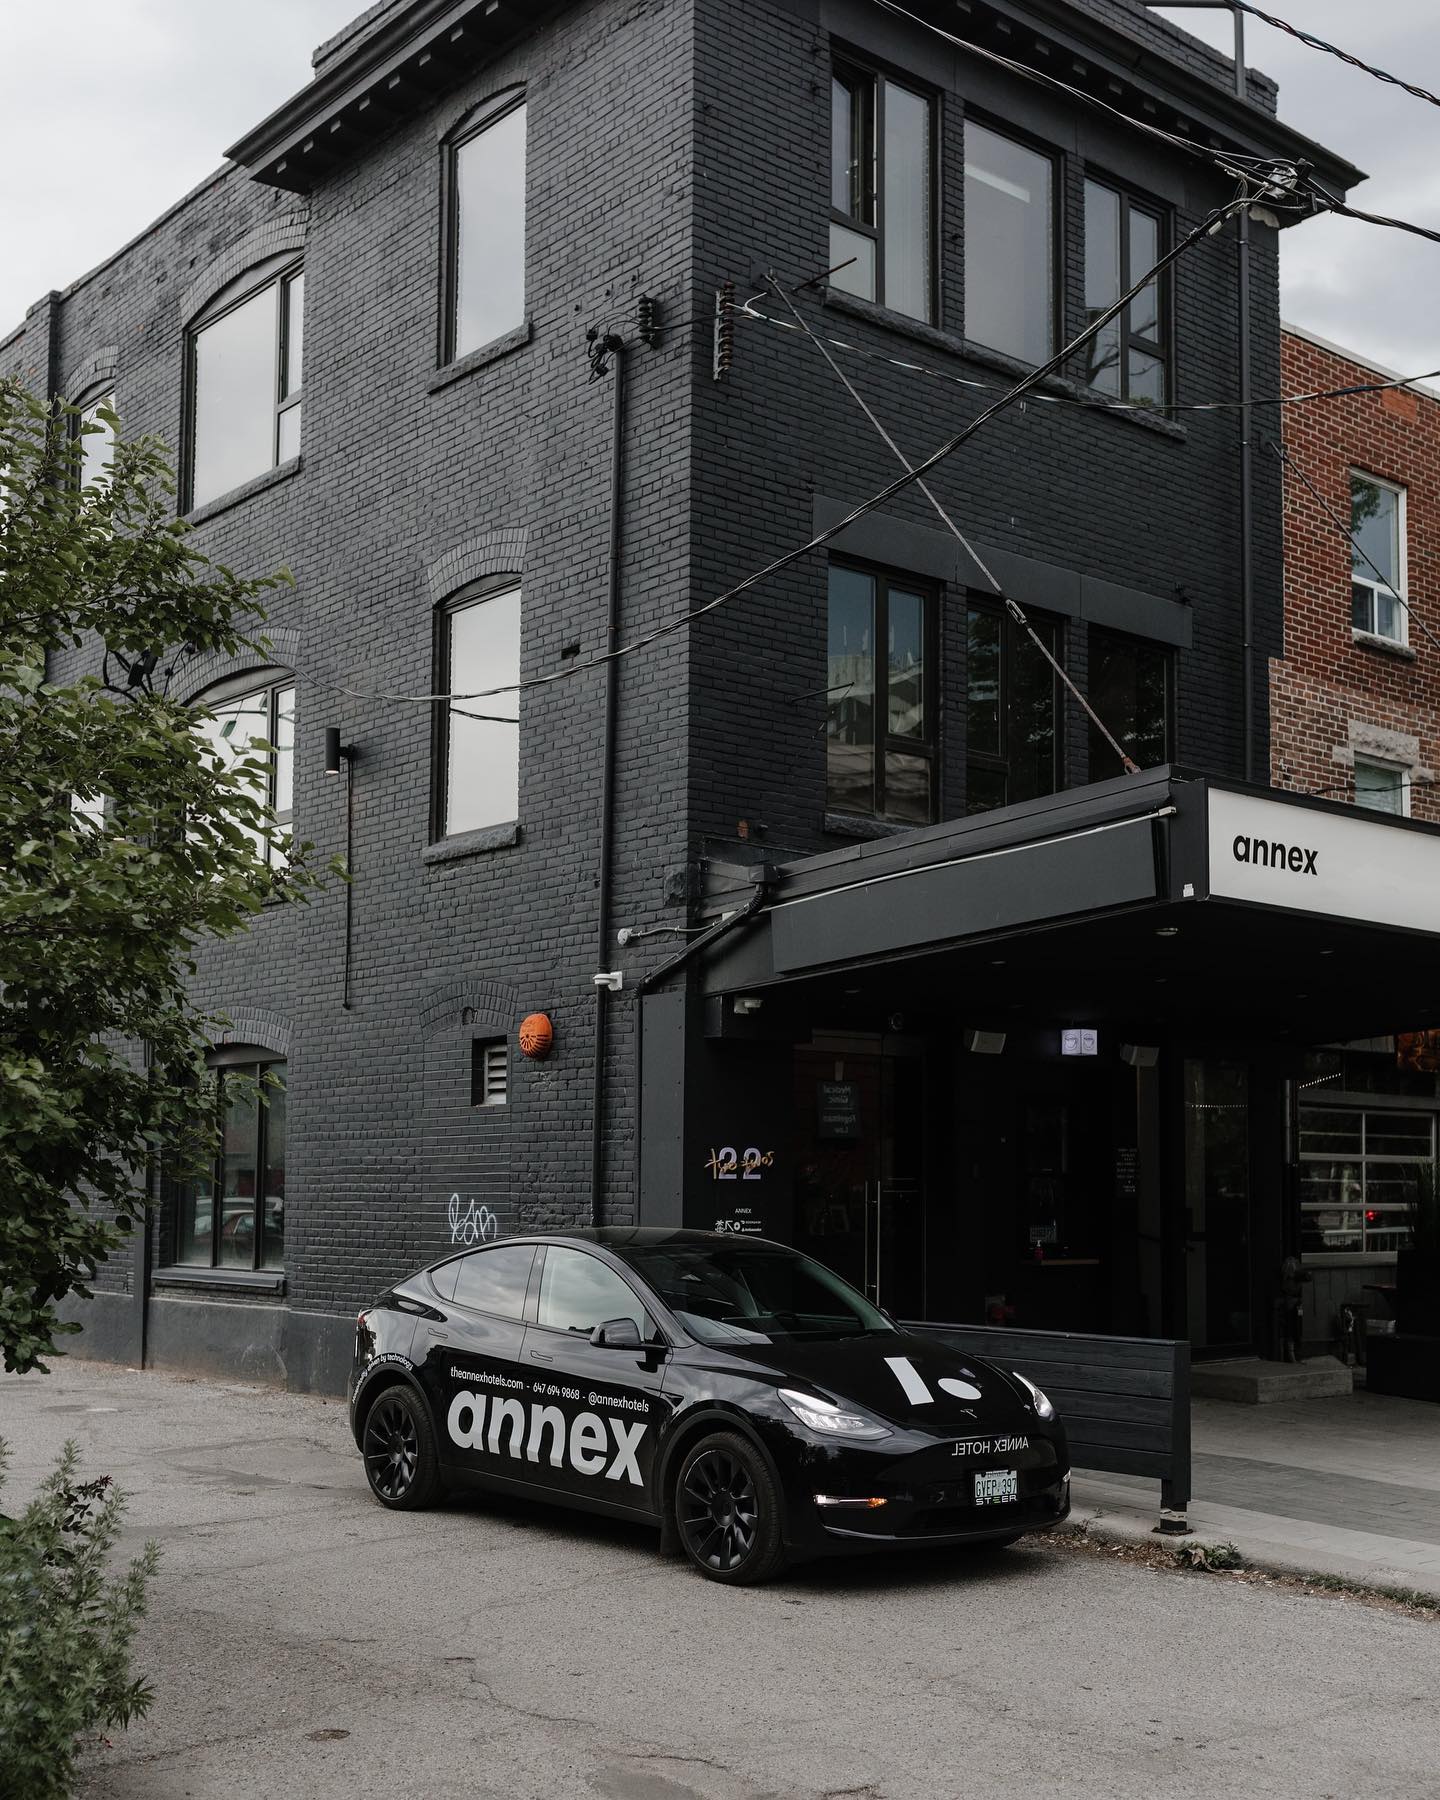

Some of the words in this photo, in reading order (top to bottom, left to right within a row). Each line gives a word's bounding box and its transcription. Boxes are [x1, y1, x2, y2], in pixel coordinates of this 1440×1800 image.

[1232, 835, 1319, 875] annex
[380, 1355, 387, 1363] by
[450, 1365, 524, 1390] theannexhotels.com
[533, 1381, 546, 1394] 647
[547, 1384, 560, 1397] 694
[561, 1386, 580, 1400] 9868
[588, 1391, 650, 1413] @annexhotels
[447, 1390, 648, 1487] annex
[975, 1495, 1017, 1506] STEER
[976, 1479, 997, 1496] GVEP
[1001, 1478, 1017, 1495] 397
